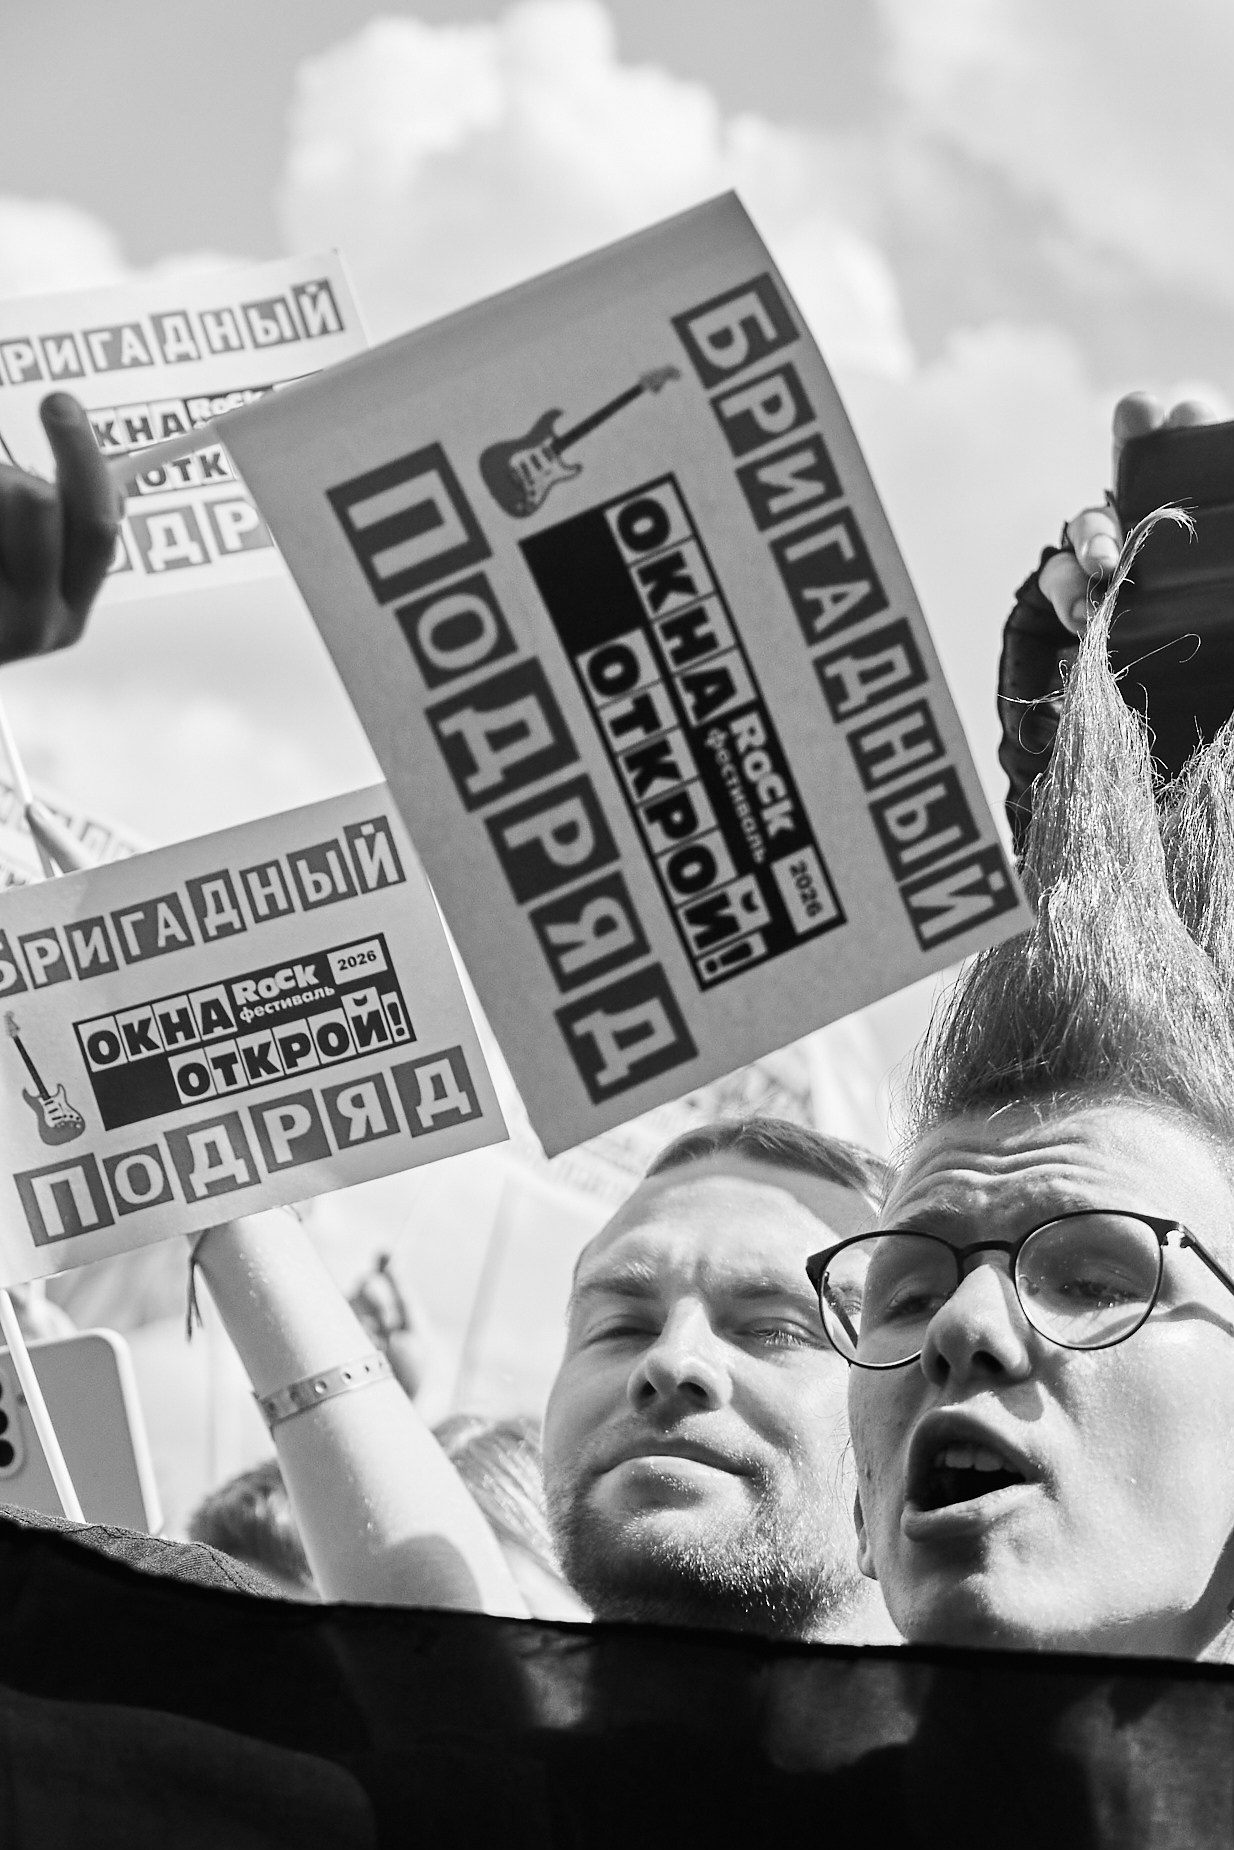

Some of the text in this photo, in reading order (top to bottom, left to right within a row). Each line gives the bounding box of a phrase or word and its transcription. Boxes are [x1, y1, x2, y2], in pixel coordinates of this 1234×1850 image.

[0, 281, 340, 385] РИГАДНЫЙ
[94, 412, 186, 449] КНА
[615, 494, 738, 722] ОКНА
[685, 286, 1007, 945] БРИГАДНЫЙ
[345, 468, 679, 1088] ПОДРЯД
[585, 648, 760, 978] ОТКРОЙ!
[704, 727, 765, 864] фестиваль
[789, 858, 823, 918] 2026
[238, 982, 336, 1026] фестиваль
[336, 948, 378, 972] 2026
[85, 1000, 236, 1066] ОКНА
[177, 989, 408, 1098] ОТКРОЙ!
[31, 1056, 473, 1238] ПОДРЯД
